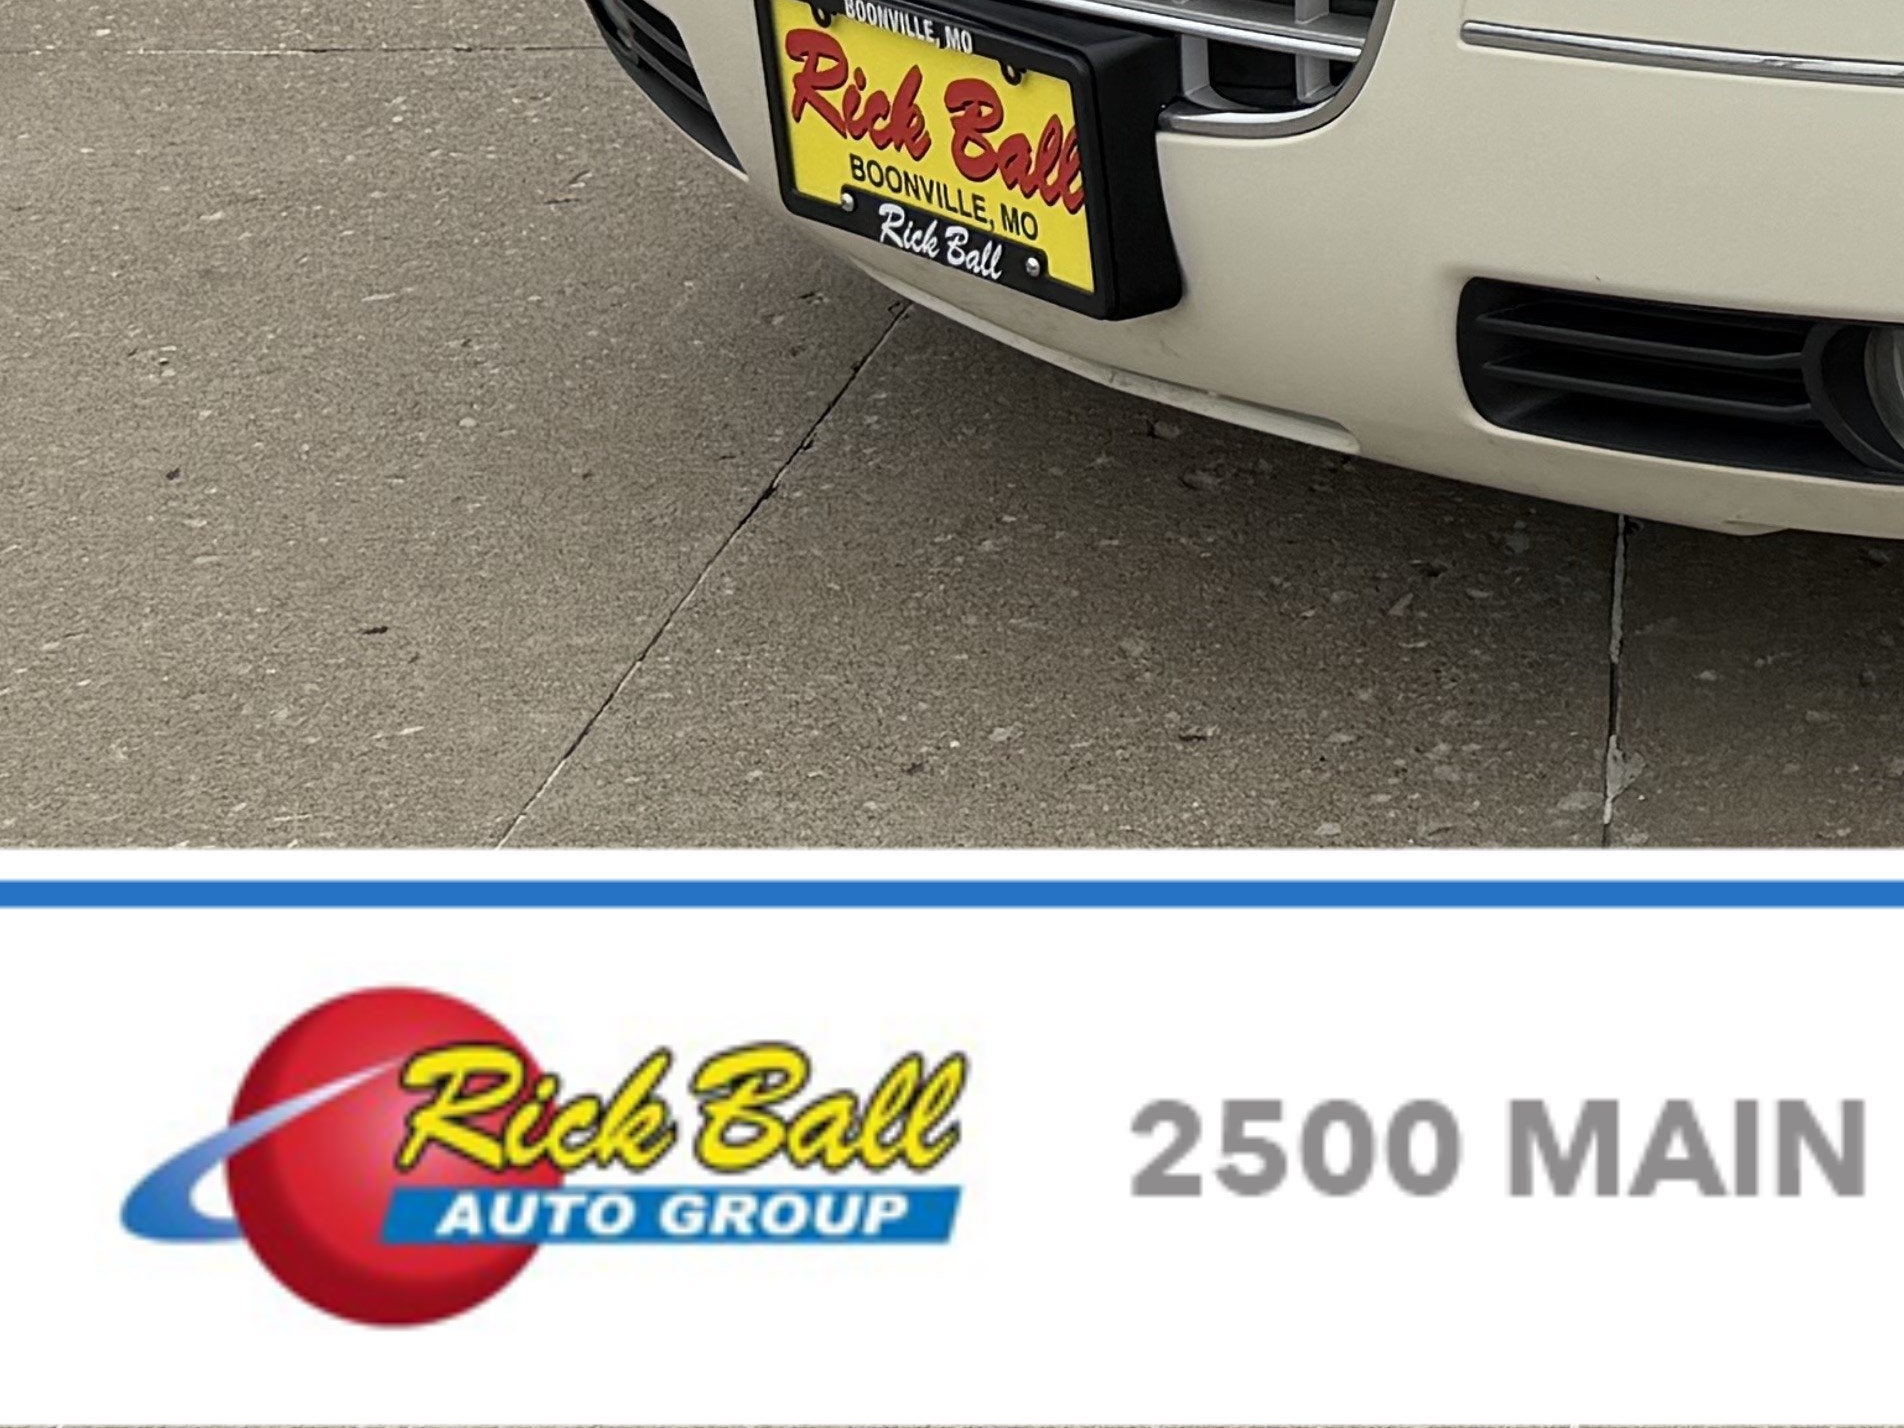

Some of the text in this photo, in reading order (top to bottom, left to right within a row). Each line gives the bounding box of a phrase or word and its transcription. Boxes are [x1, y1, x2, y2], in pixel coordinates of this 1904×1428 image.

[944, 25, 974, 55] MO
[785, 28, 1087, 215] Rick Ball
[848, 153, 1039, 241] BOONVILLE, MO
[878, 203, 1003, 281] Rick Ball
